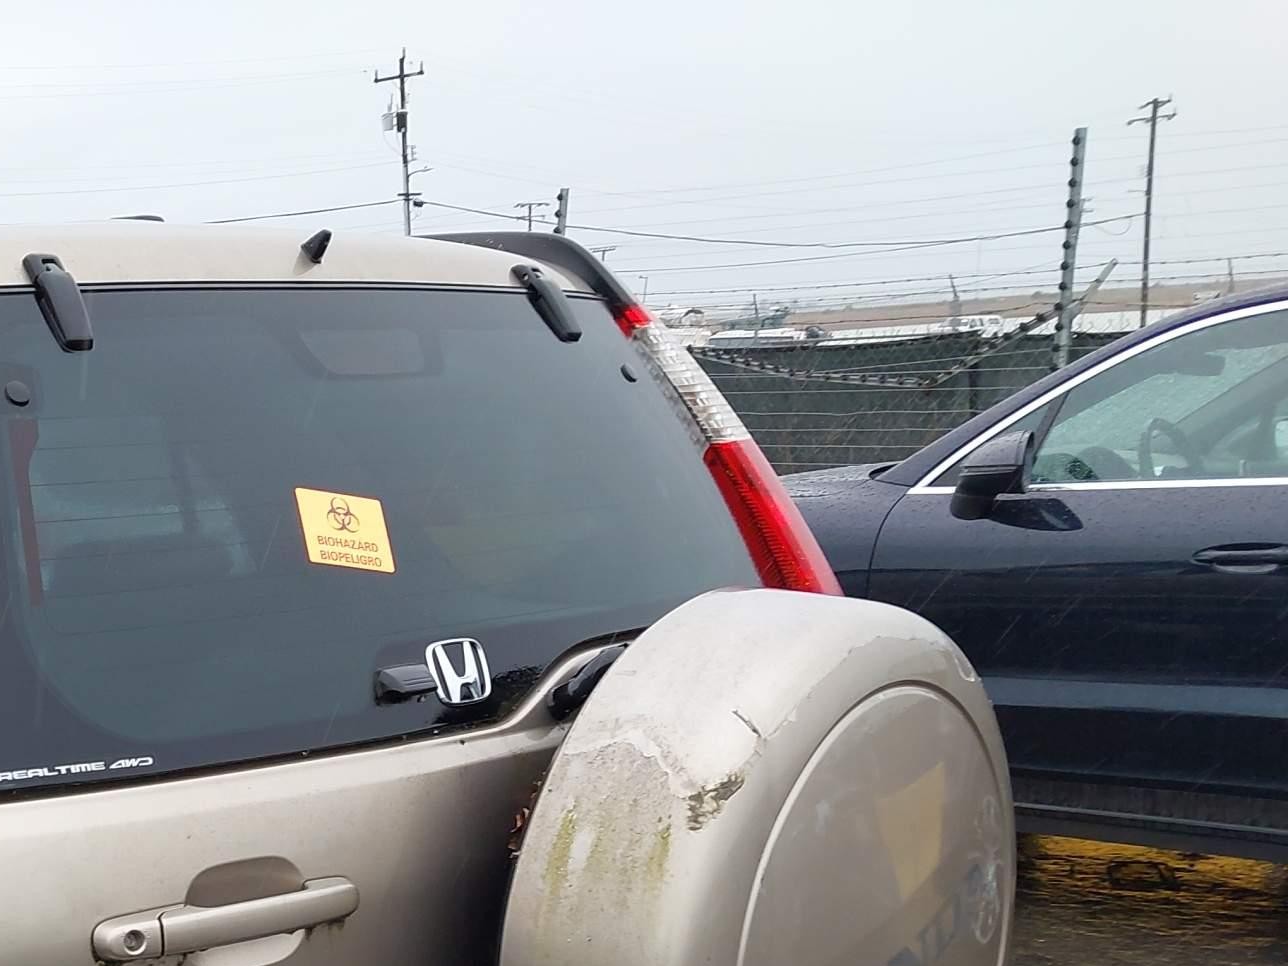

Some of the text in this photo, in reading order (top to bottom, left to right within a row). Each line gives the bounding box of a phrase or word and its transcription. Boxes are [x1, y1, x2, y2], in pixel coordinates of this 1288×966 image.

[317, 535, 379, 553] BIOHAZARD
[320, 550, 382, 567] BIOPELIGRO
[109, 756, 153, 769] 4WD
